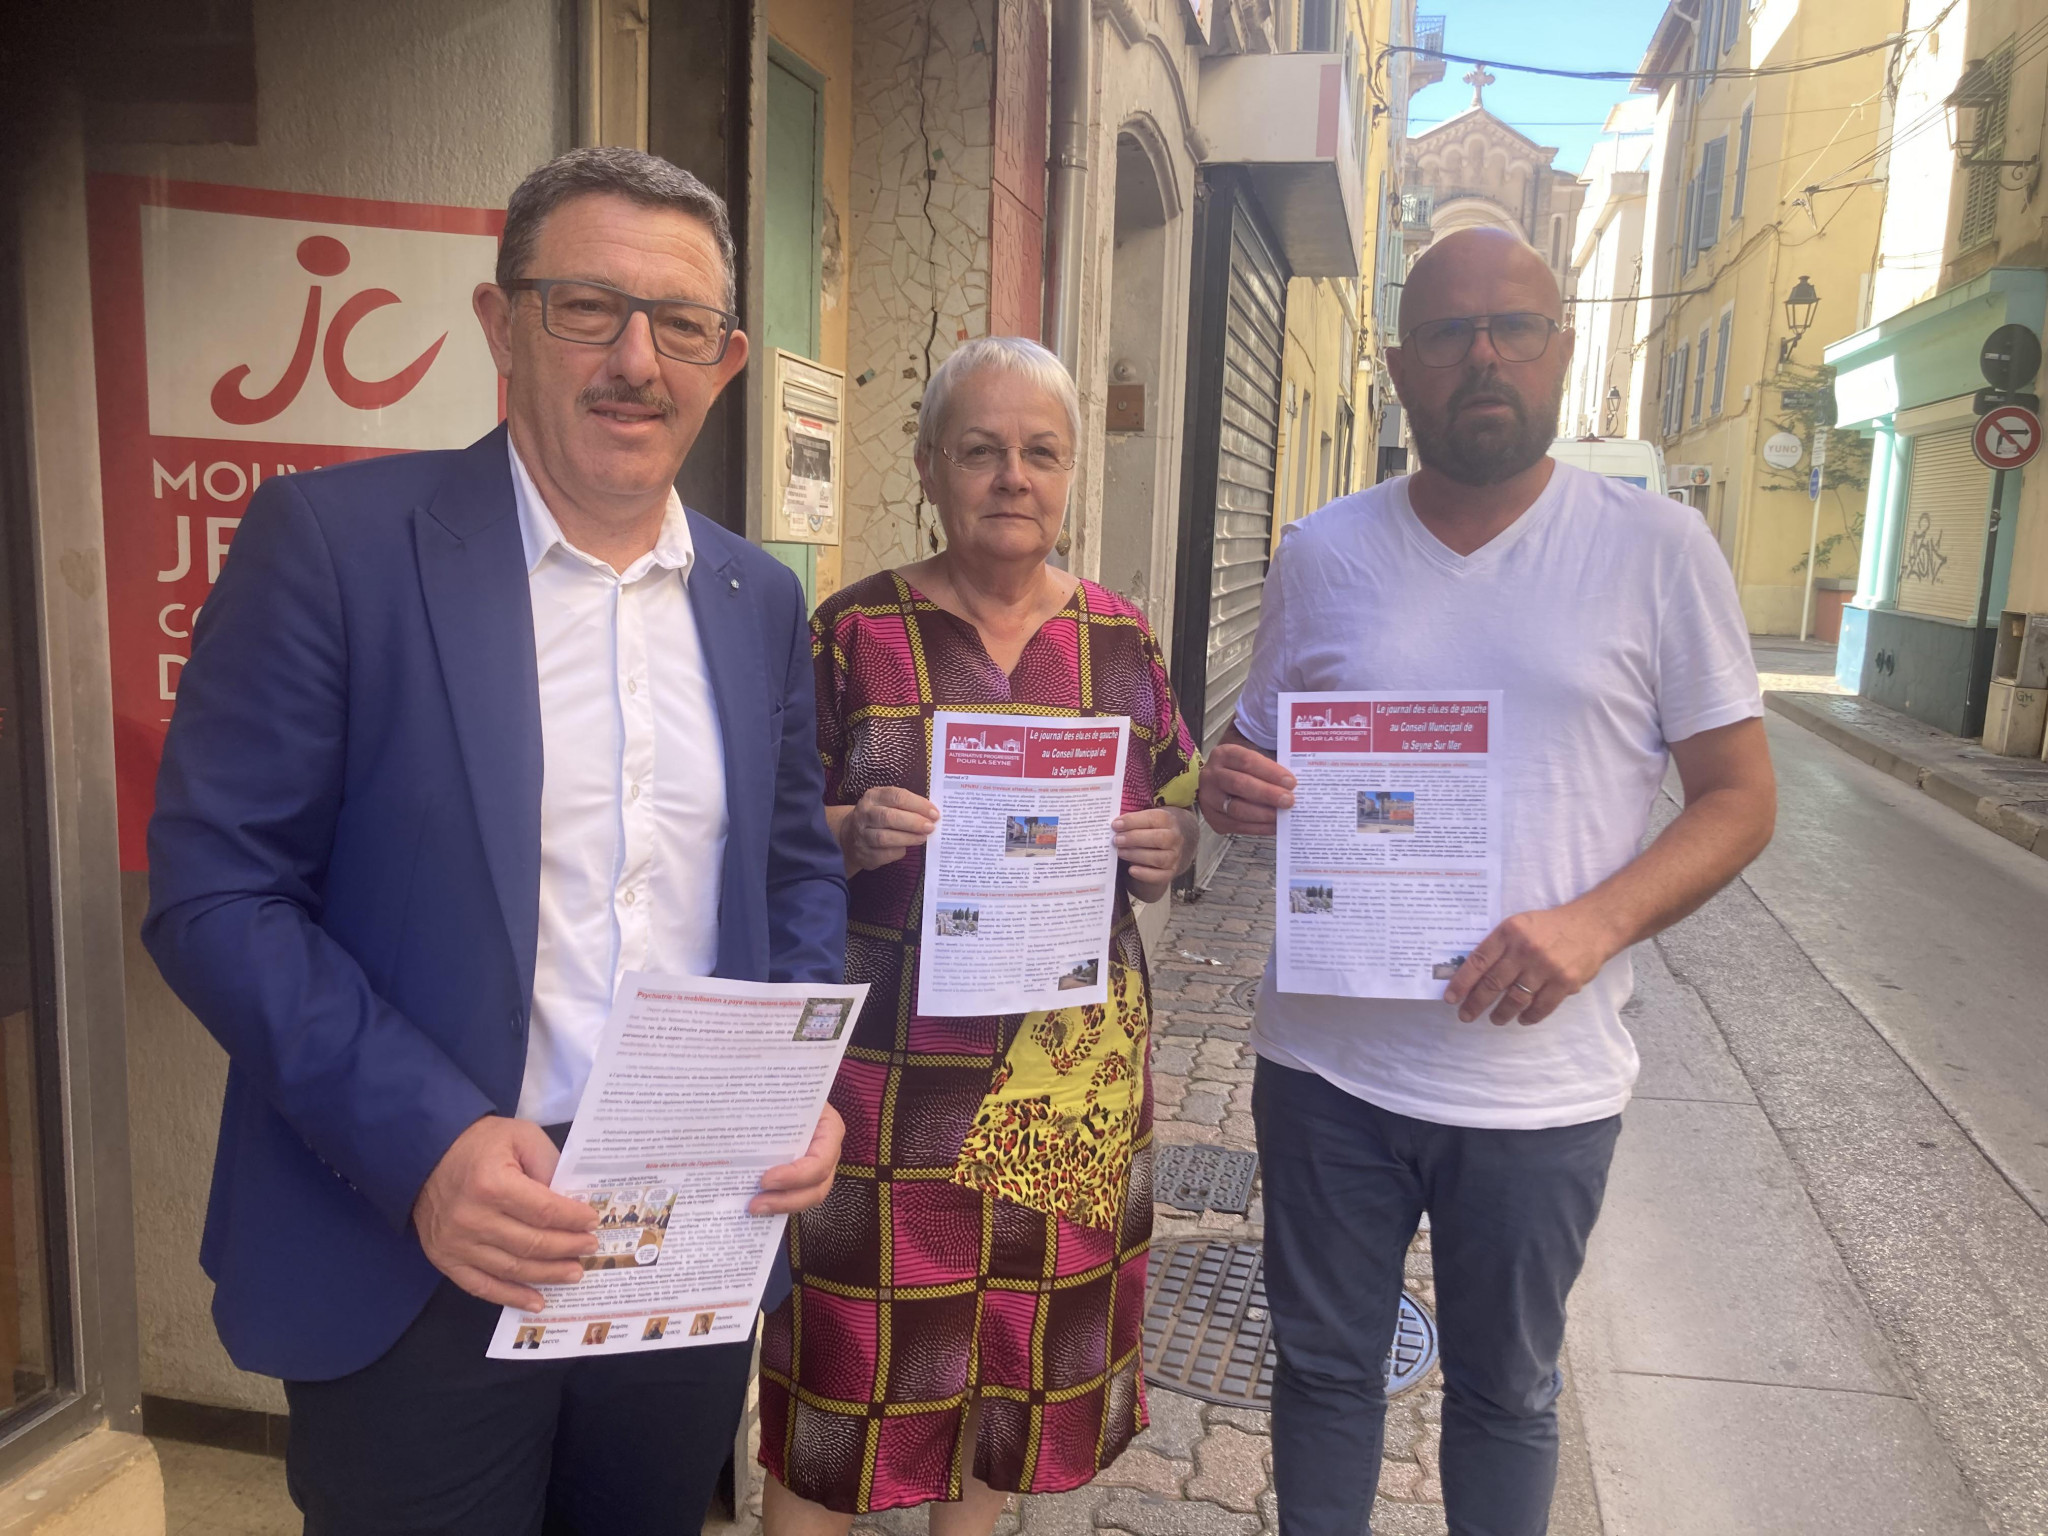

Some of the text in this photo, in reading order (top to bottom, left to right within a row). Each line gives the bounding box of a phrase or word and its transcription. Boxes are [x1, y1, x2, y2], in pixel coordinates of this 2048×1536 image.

[1768, 444, 1798, 453] YUNO
[1377, 704, 1385, 713] Le
[1386, 704, 1413, 716] journal
[1413, 704, 1425, 714] des
[1449, 704, 1458, 713] de
[1461, 704, 1487, 716] gauche
[1390, 722, 1473, 734] au Conseil Municipal de
[1030, 730, 1039, 739] Le
[1039, 731, 1063, 742] journal
[1064, 731, 1074, 740] des
[1092, 731, 1099, 739] de
[1100, 730, 1118, 741] gauche
[1402, 740, 1461, 752] la Seyne Sur Mer
[1042, 747, 1107, 759] au Conseil Municipal de
[1052, 766, 1097, 778] la Seyne Sur Mer
[637, 991, 672, 1000] Psychiatrie
[684, 995, 722, 1004] mobilisation
[728, 998, 742, 1006] payé
[698, 1160, 730, 1168] l'opposition
